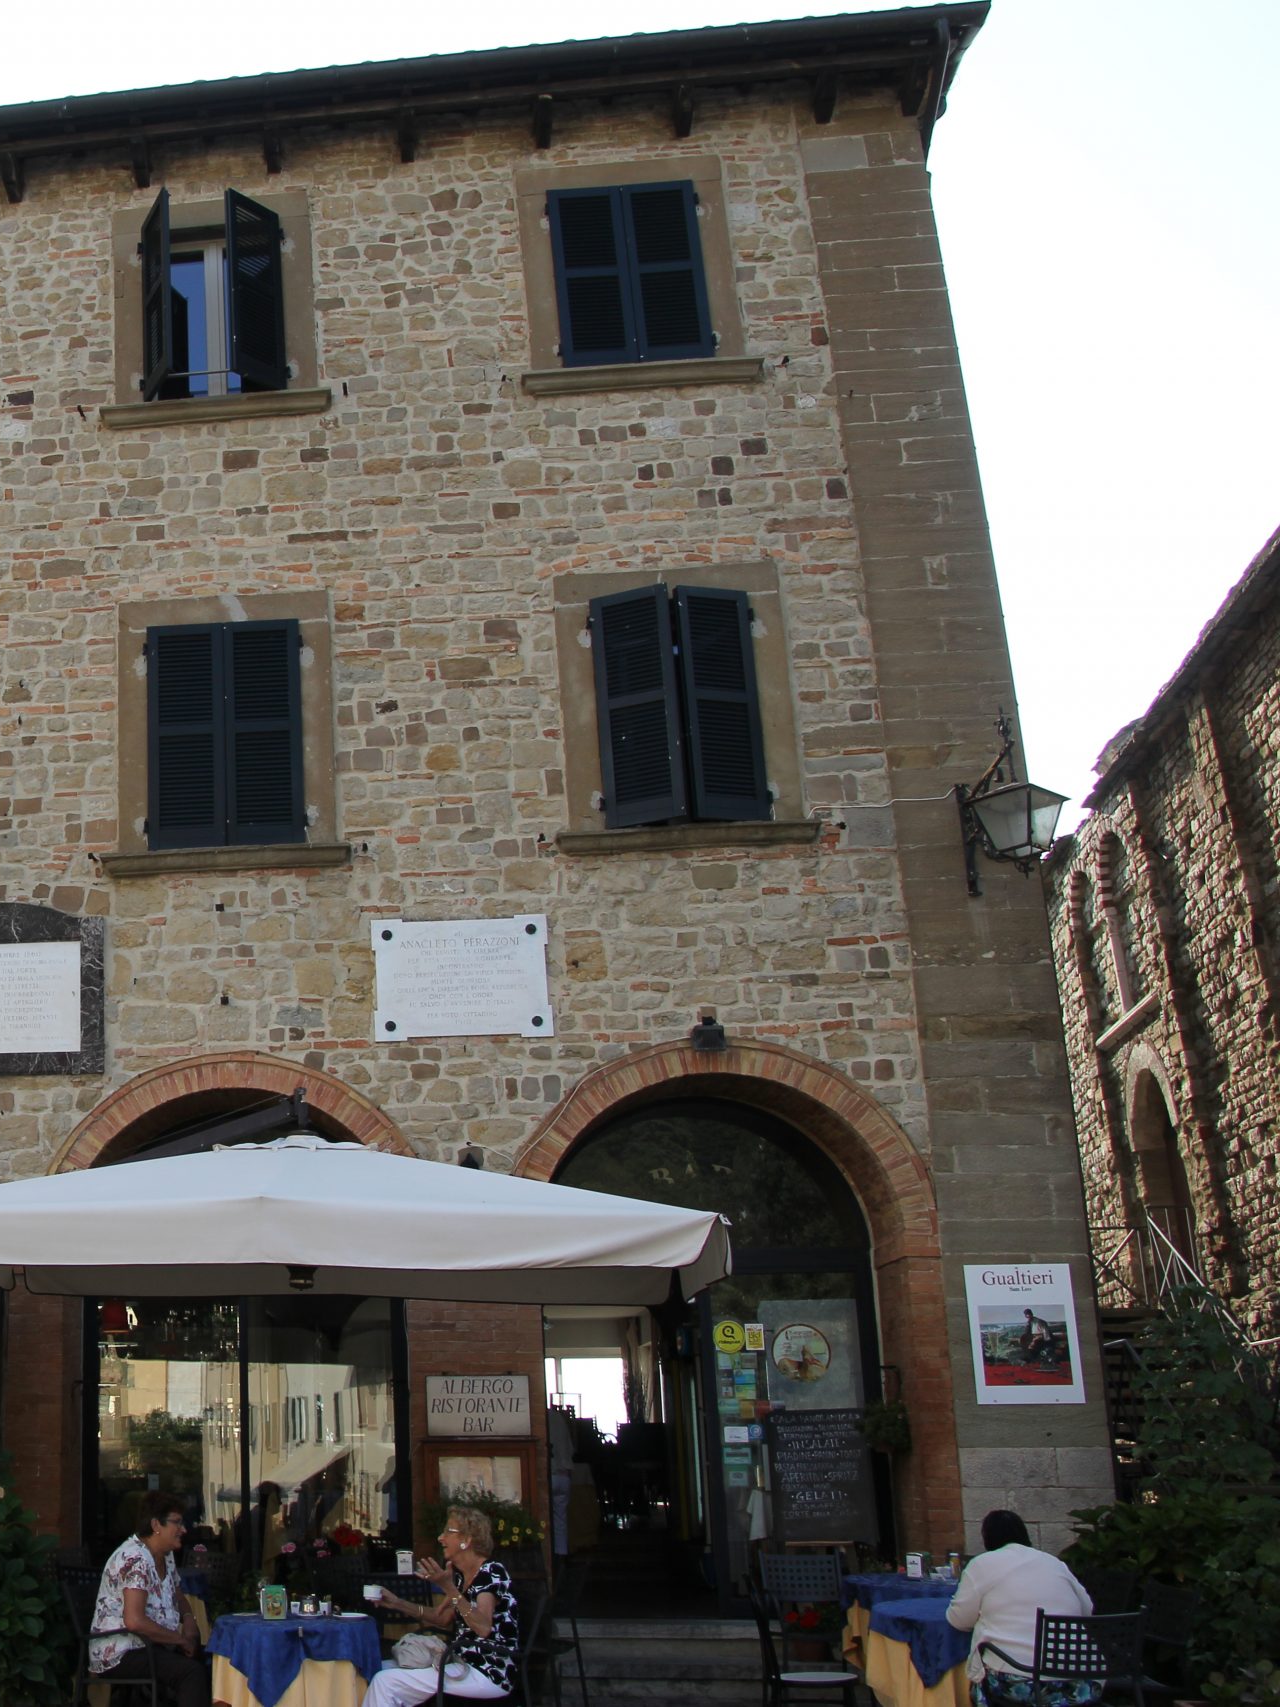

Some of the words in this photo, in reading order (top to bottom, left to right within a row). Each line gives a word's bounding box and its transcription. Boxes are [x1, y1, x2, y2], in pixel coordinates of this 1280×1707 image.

[400, 938, 457, 949] ANACLETO
[464, 936, 520, 947] PERAZZONI
[981, 1269, 1054, 1286] Gualtieri
[440, 1378, 513, 1395] ALBERGO
[431, 1397, 526, 1413] RISTORANTE
[463, 1416, 494, 1432] BAR
